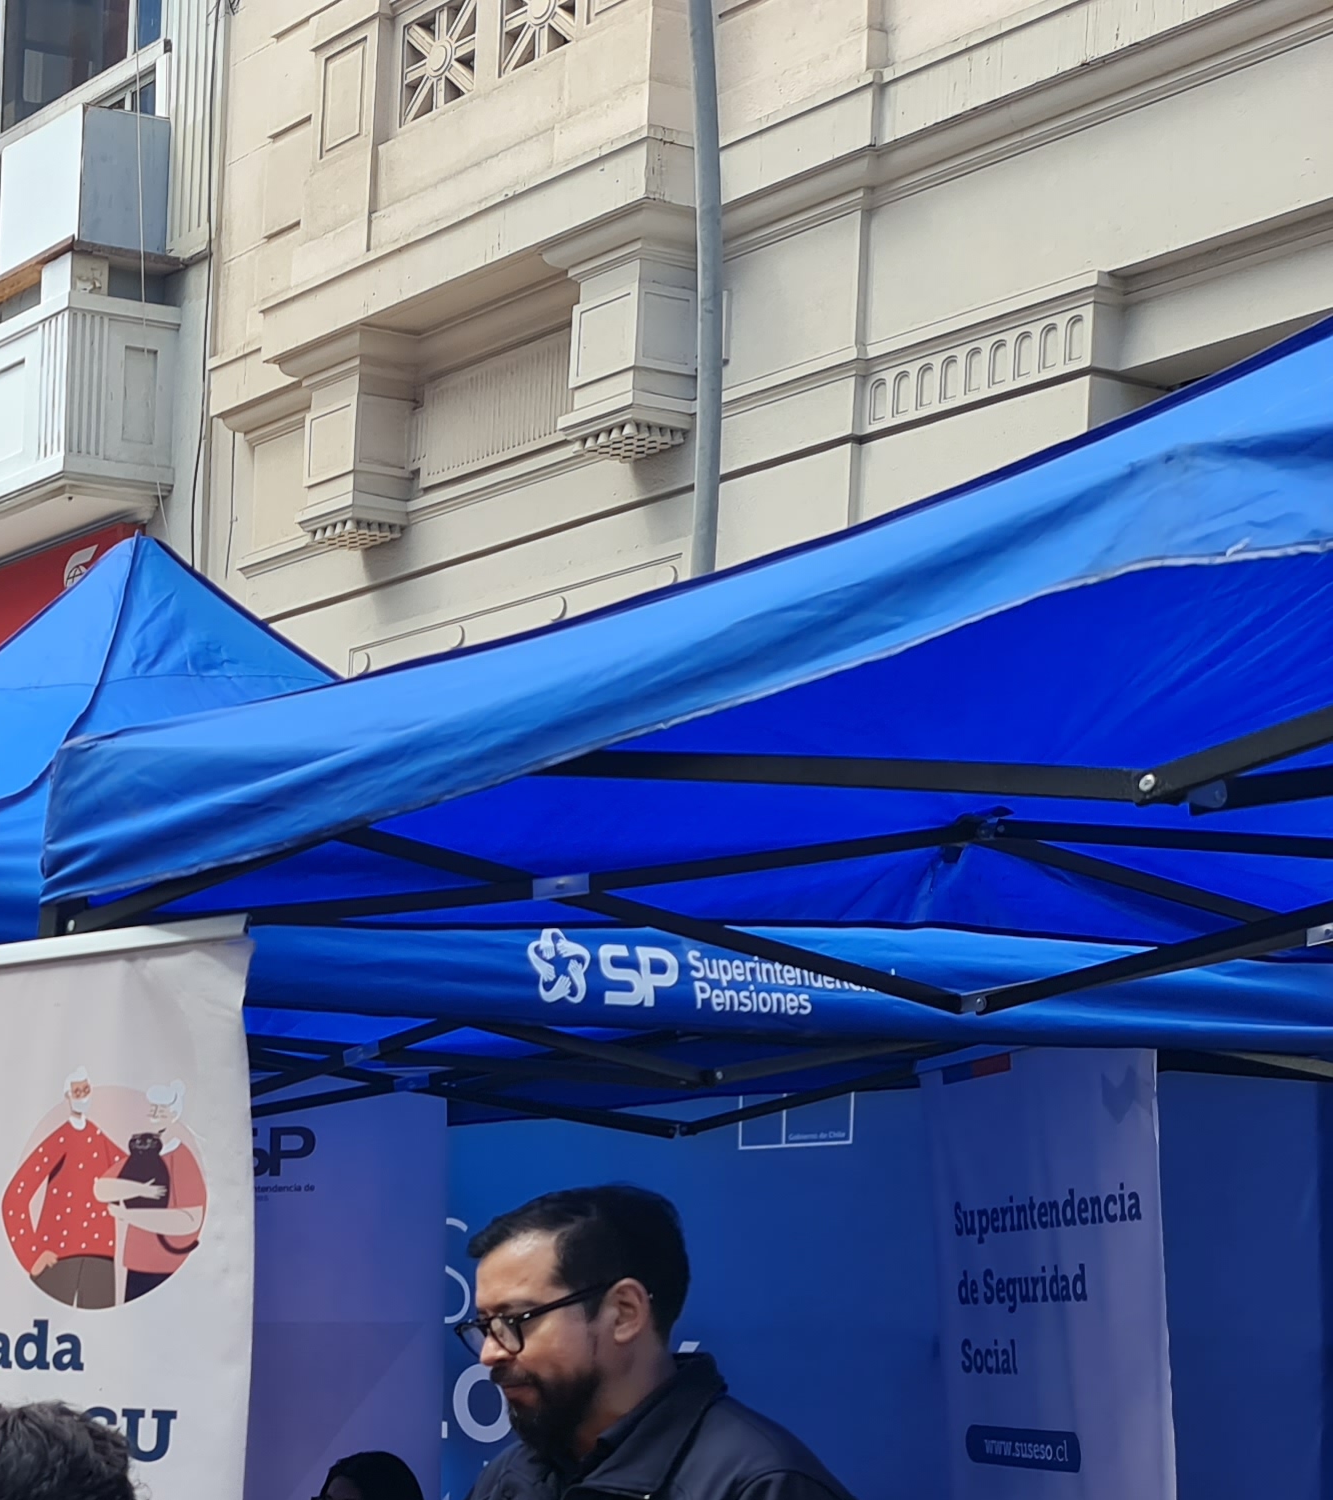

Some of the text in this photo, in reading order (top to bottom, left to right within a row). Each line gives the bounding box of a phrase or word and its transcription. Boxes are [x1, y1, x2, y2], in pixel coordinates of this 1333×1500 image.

[598, 944, 679, 1007] SP
[694, 982, 811, 1014] Pensiones
[954, 1182, 1142, 1244] Superintendencia
[958, 1264, 1088, 1313] de Seguridad
[961, 1338, 1018, 1375] Social
[984, 1439, 1069, 1462] www.suseso.cl
